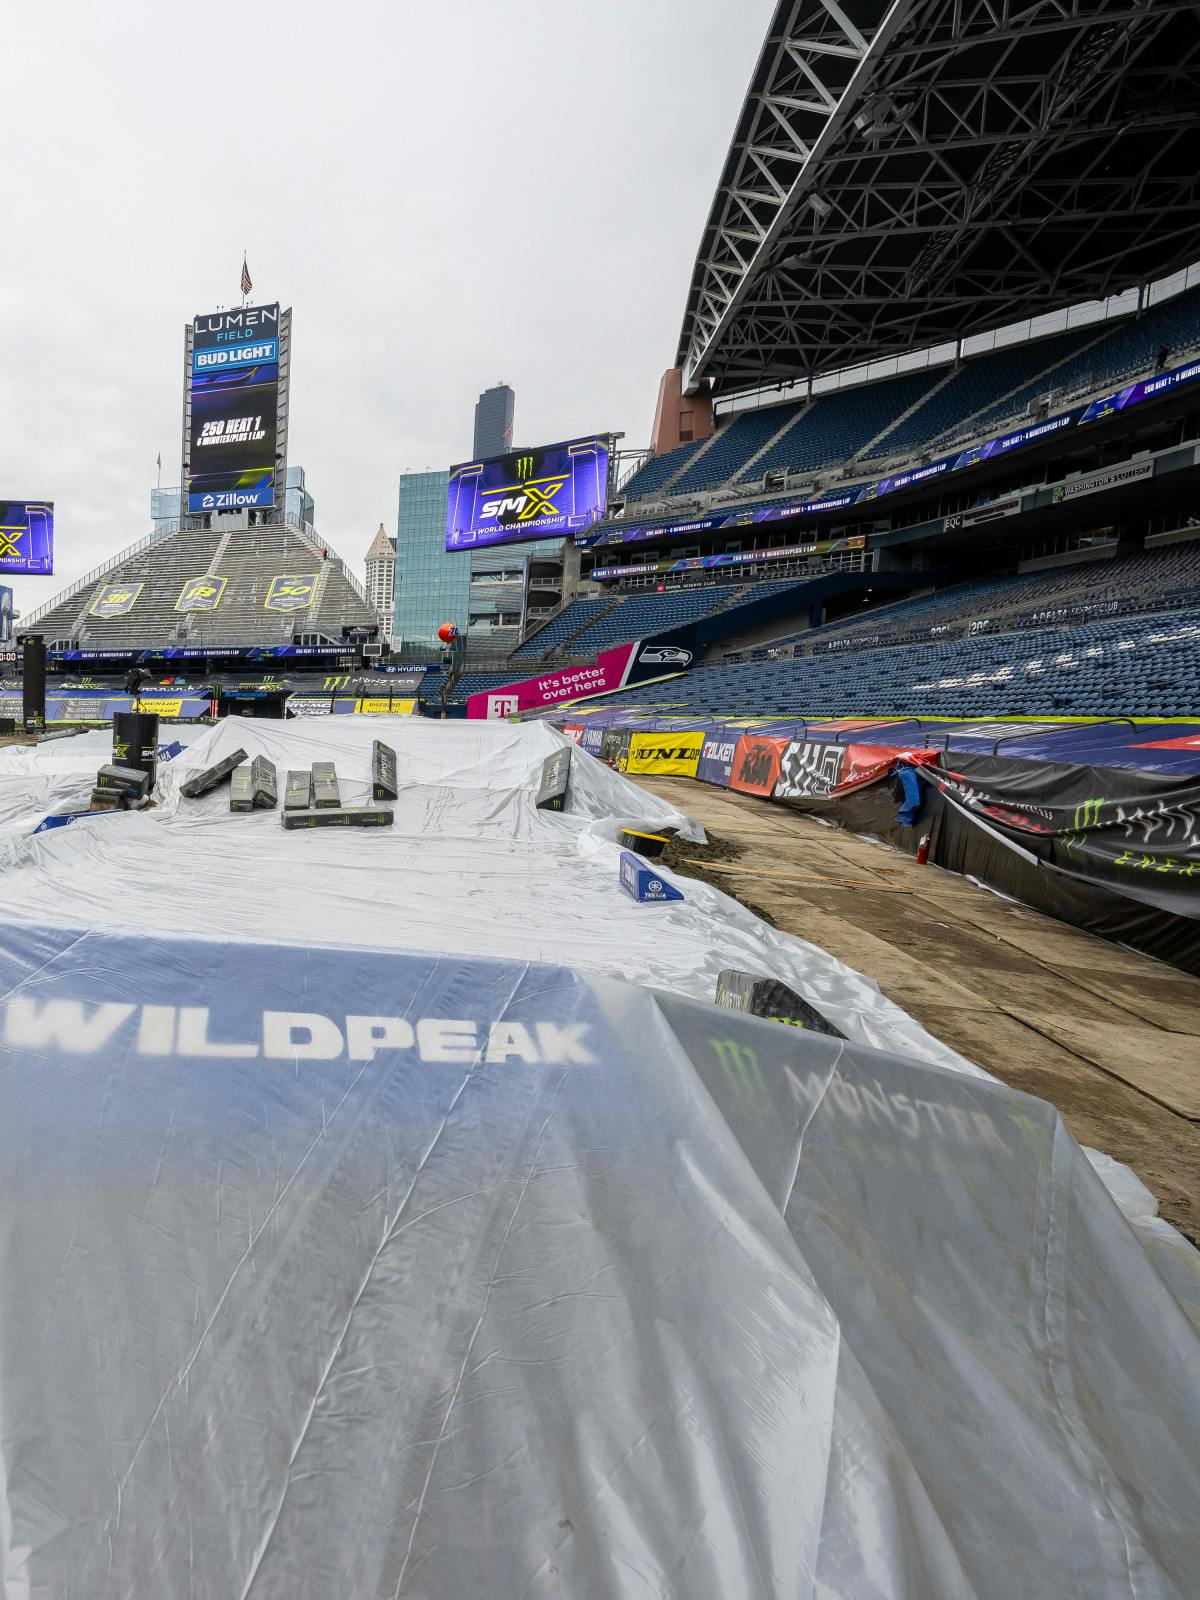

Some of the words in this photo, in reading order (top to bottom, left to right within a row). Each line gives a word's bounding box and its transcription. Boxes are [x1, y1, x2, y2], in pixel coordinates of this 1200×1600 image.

[195, 308, 278, 334] LUMEN
[217, 328, 253, 342] FIELD
[197, 352, 228, 366] BUD
[1155, 378, 1168, 390] HEAT
[201, 420, 225, 437] 250
[225, 417, 254, 434] HEAT
[254, 415, 262, 431] 1
[201, 432, 247, 446] MINUTES/PLUS
[252, 430, 265, 440] LAP
[1064, 475, 1115, 495] WASHINGTON'S
[1117, 465, 1150, 481] LOTTERY
[216, 492, 259, 507] Zillow
[480, 482, 564, 520] SMX
[477, 525, 504, 535] WORLD
[505, 515, 565, 531] CHAMPIONSHIP
[945, 515, 961, 529] EQC
[538, 678, 559, 691] It's
[562, 668, 606, 686] better
[542, 687, 573, 701] over
[575, 677, 606, 693] here
[703, 741, 736, 763] FALKEN
[4, 997, 600, 1066] WILDPEAK
[783, 1064, 1014, 1156] MONSTER
